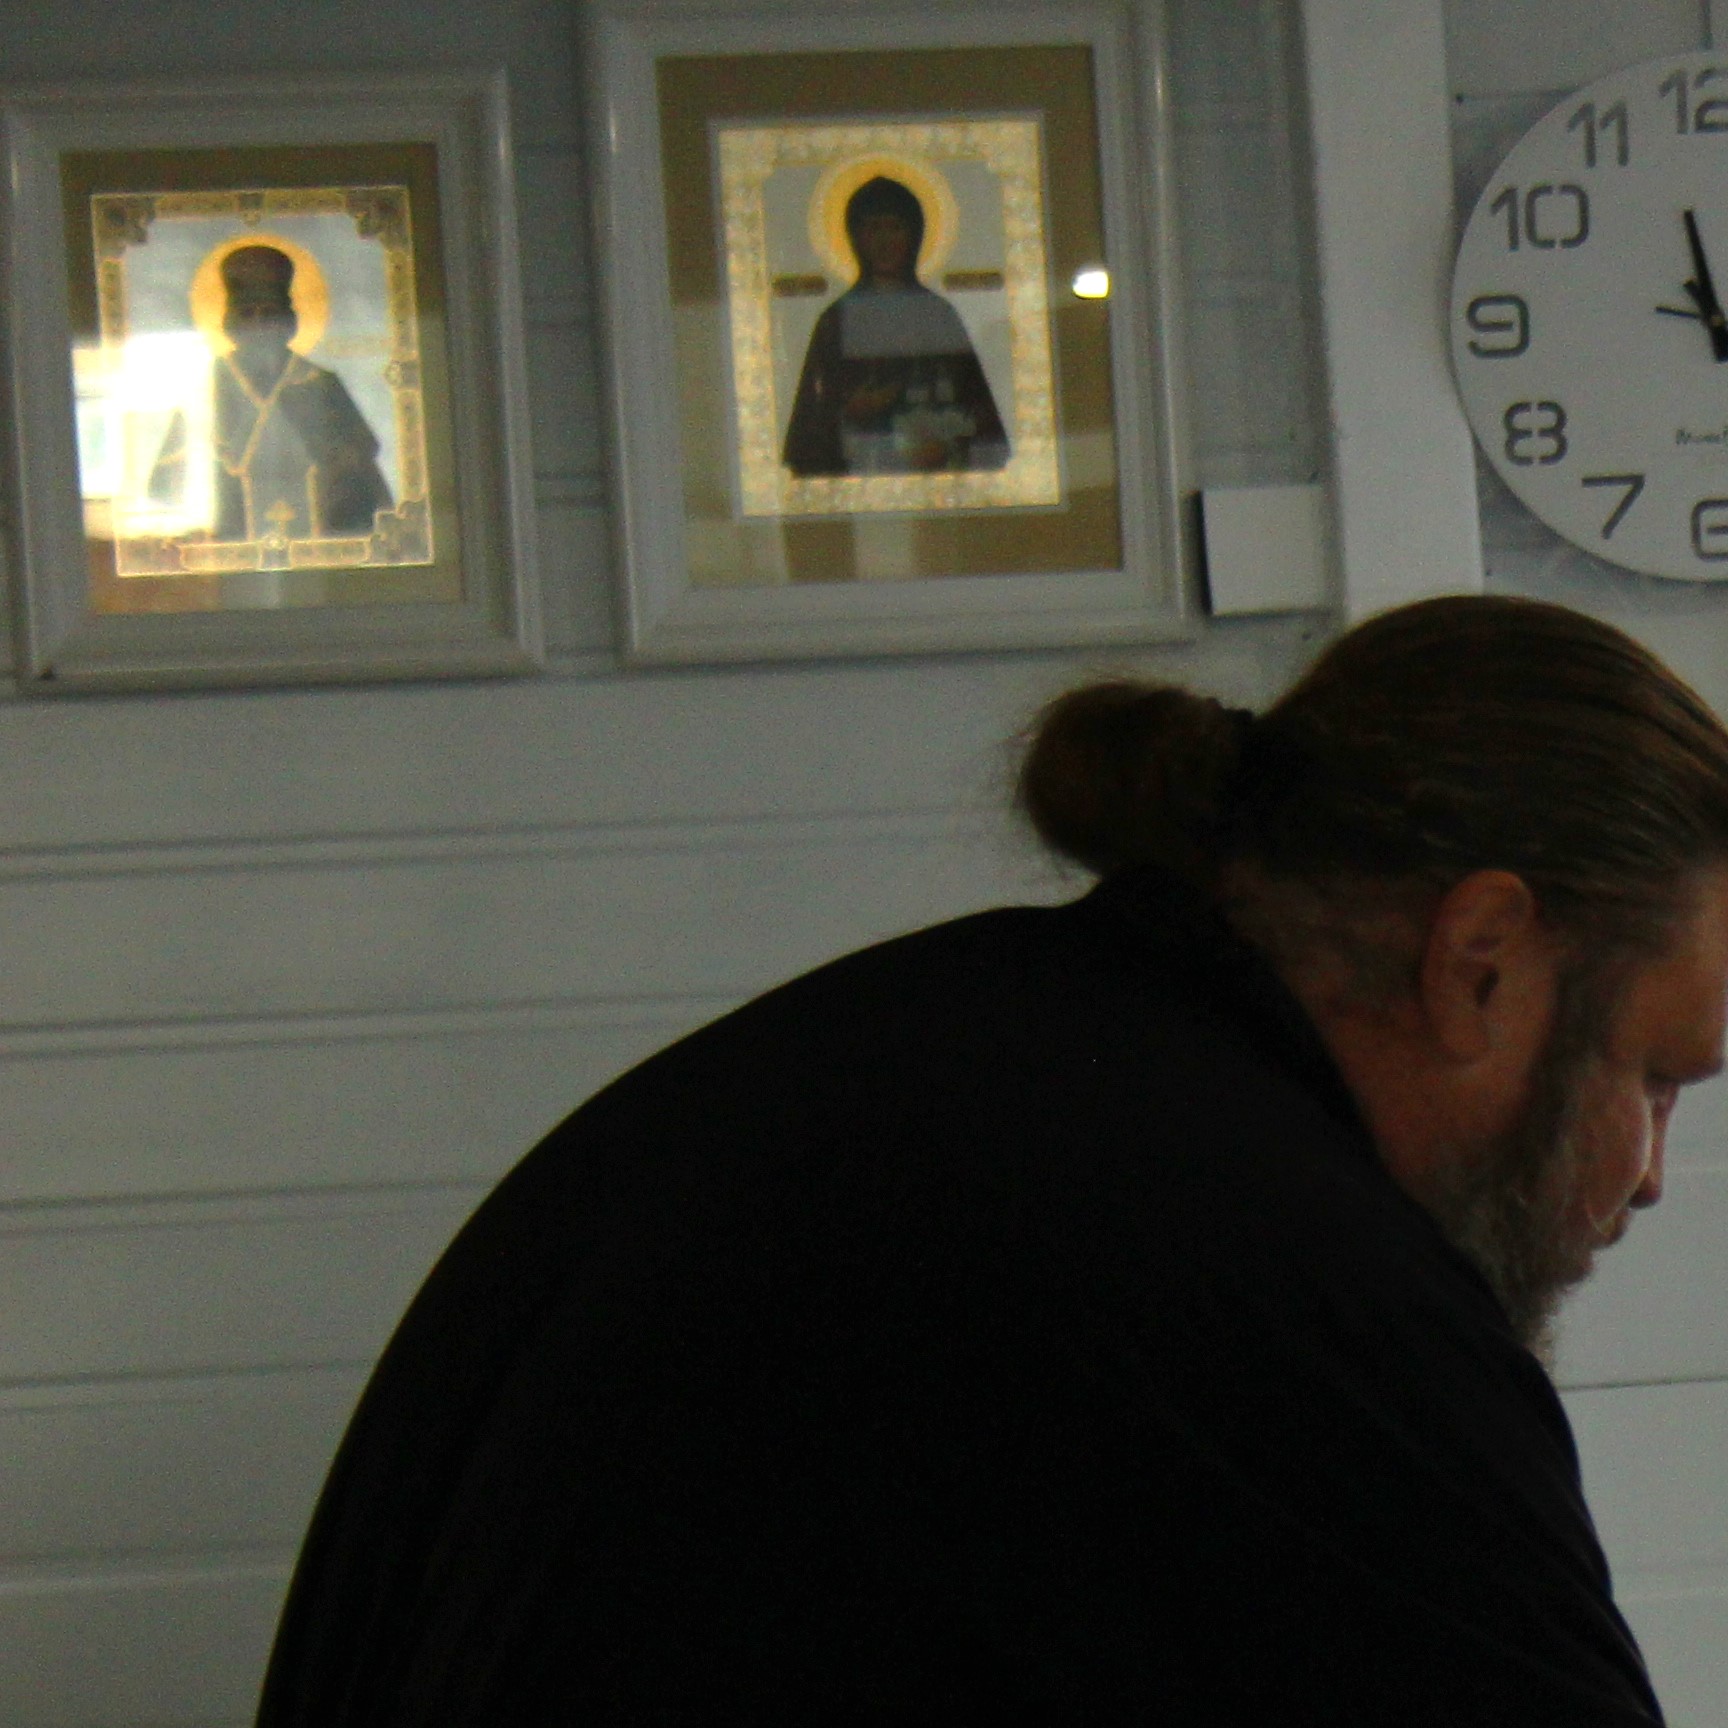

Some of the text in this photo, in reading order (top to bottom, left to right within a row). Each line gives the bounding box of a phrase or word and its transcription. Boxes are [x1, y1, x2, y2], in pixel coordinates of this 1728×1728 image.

[1567, 102, 1629, 168] 11
[1491, 183, 1590, 250] 10
[1466, 294, 1530, 358] 9
[1503, 400, 1567, 465] 8
[1582, 473, 1645, 539] 7
